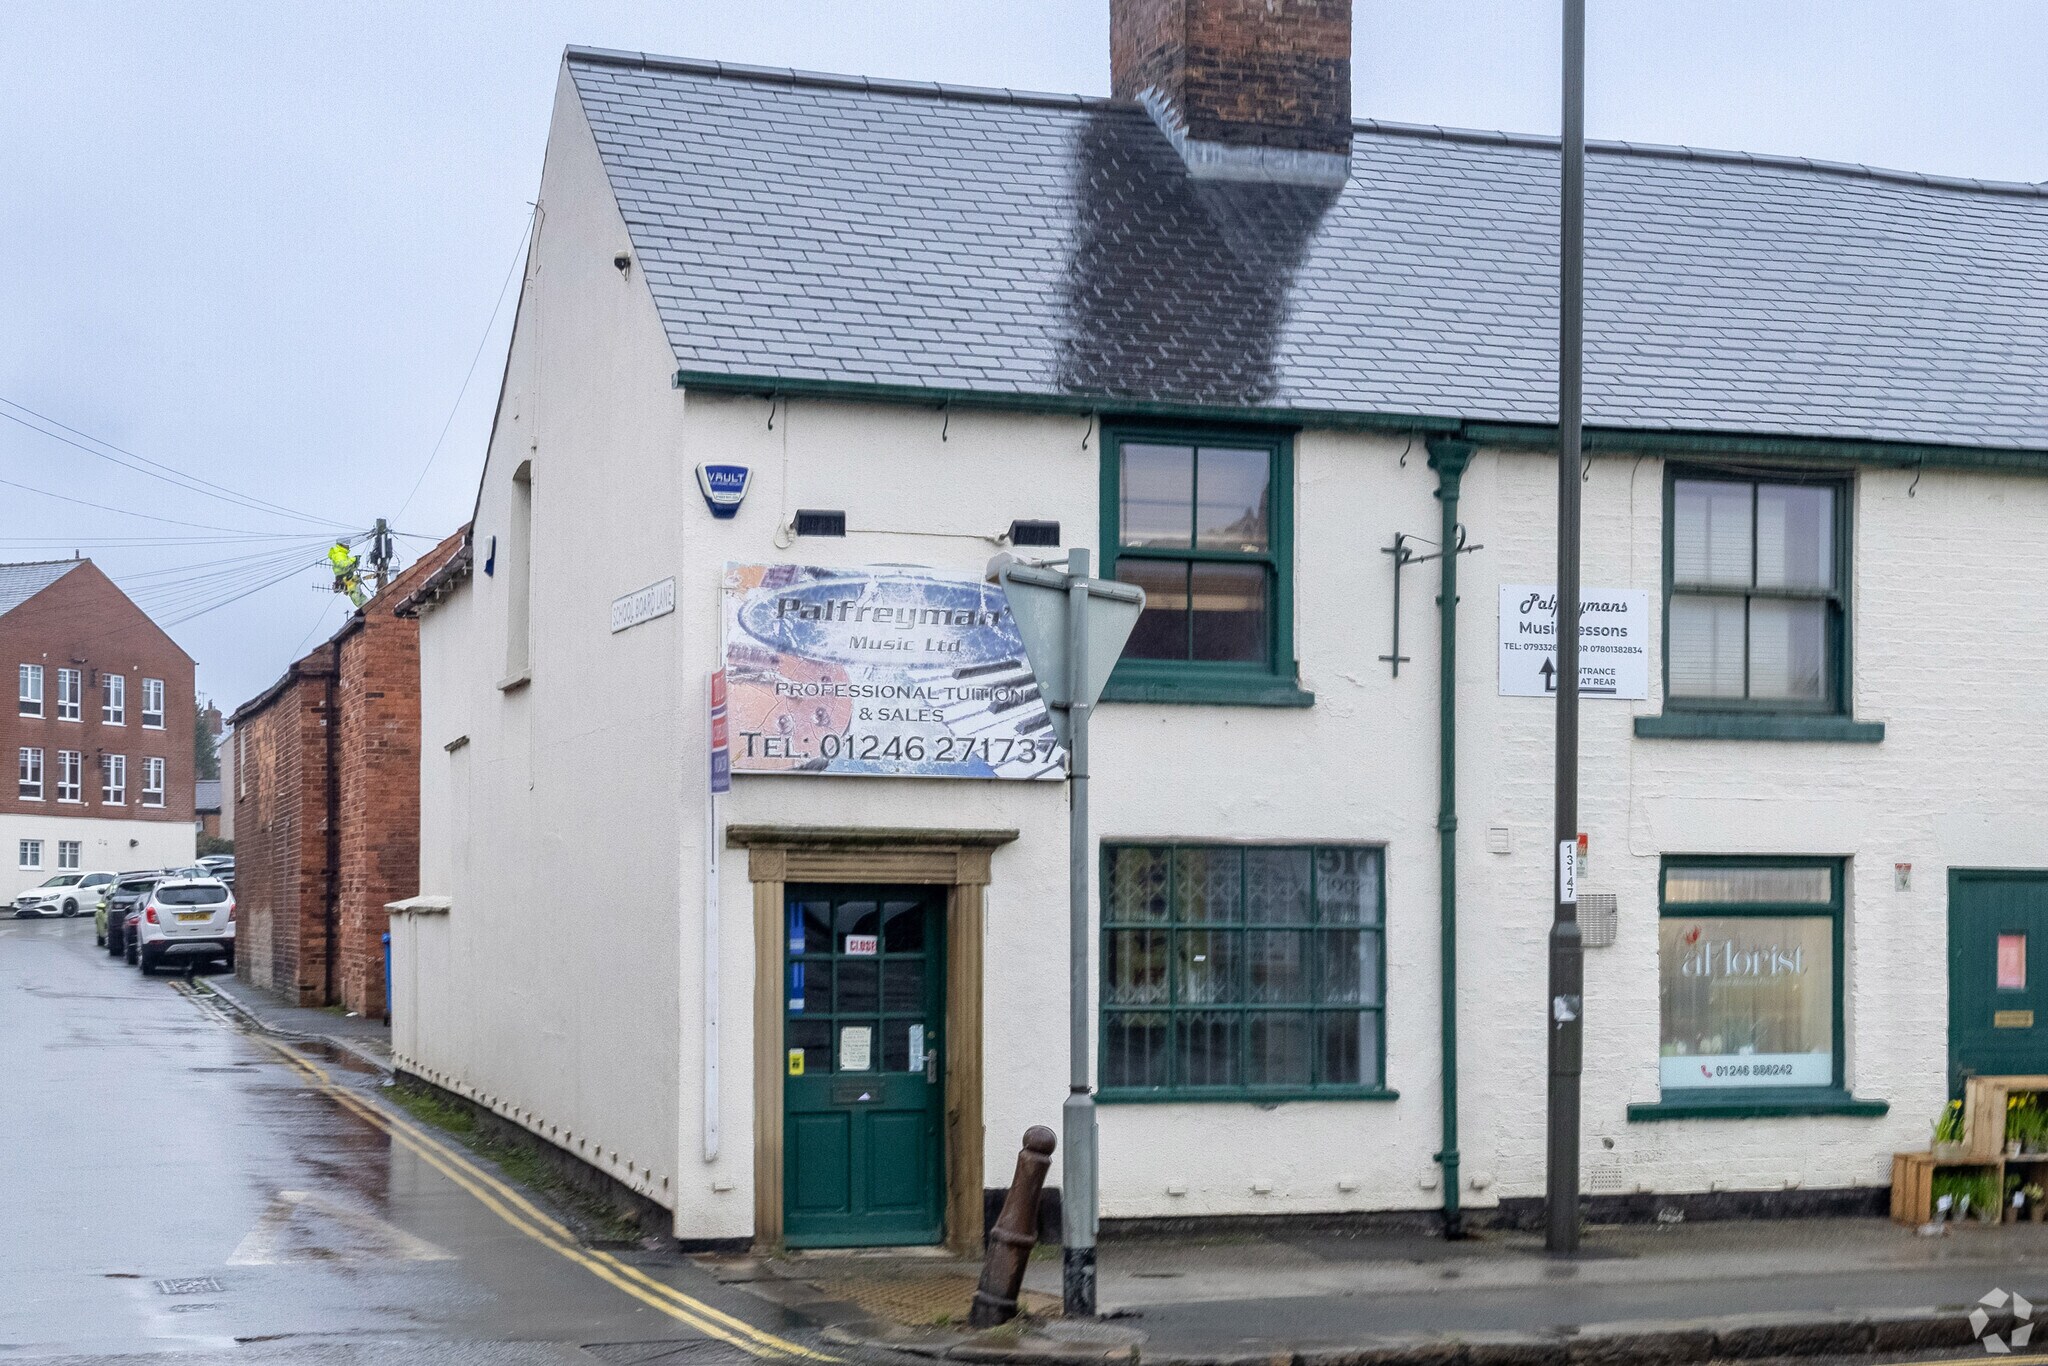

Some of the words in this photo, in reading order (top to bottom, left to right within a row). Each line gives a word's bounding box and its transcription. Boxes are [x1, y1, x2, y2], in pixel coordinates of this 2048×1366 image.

[708, 472, 745, 482] VAULT
[1519, 621, 1558, 635] Musi
[1578, 625, 1628, 637] essons
[849, 635, 915, 651] Music
[925, 638, 961, 653] Ltd
[1580, 677, 1592, 685] AT
[1593, 678, 1616, 686] REAR
[775, 682, 940, 701] PROFESSIONAL
[943, 687, 1026, 702] TUITION
[859, 707, 873, 721] &
[878, 708, 944, 723] SALES
[820, 733, 926, 763] 01246
[934, 736, 1059, 765] 271737
[1715, 1064, 1751, 1078] 01246
